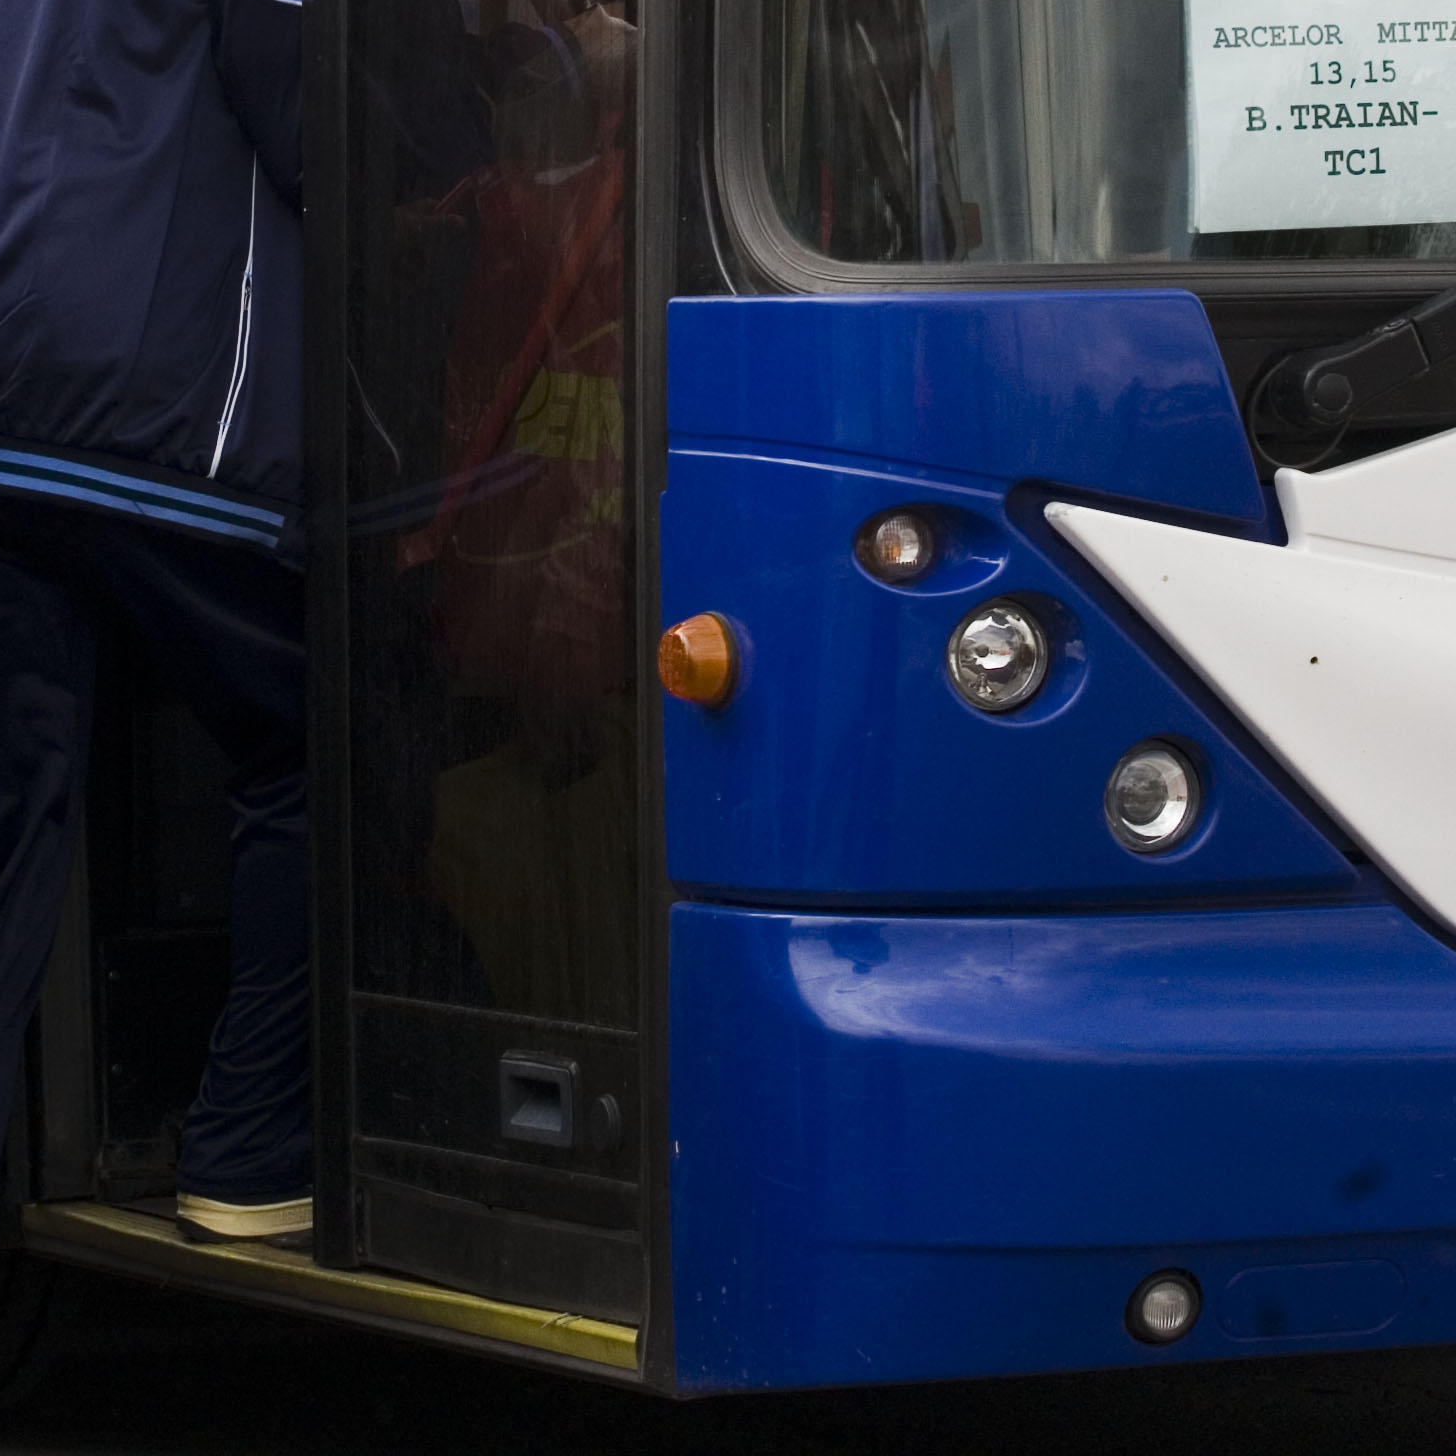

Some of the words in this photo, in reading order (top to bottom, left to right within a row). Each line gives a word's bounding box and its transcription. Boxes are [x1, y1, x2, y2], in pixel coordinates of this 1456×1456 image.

[1213, 24, 1344, 49] ARCELOR
[1309, 59, 1397, 89] 13,15
[1245, 100, 1439, 132] B.TRAIAN-
[1324, 146, 1387, 177] TC1
